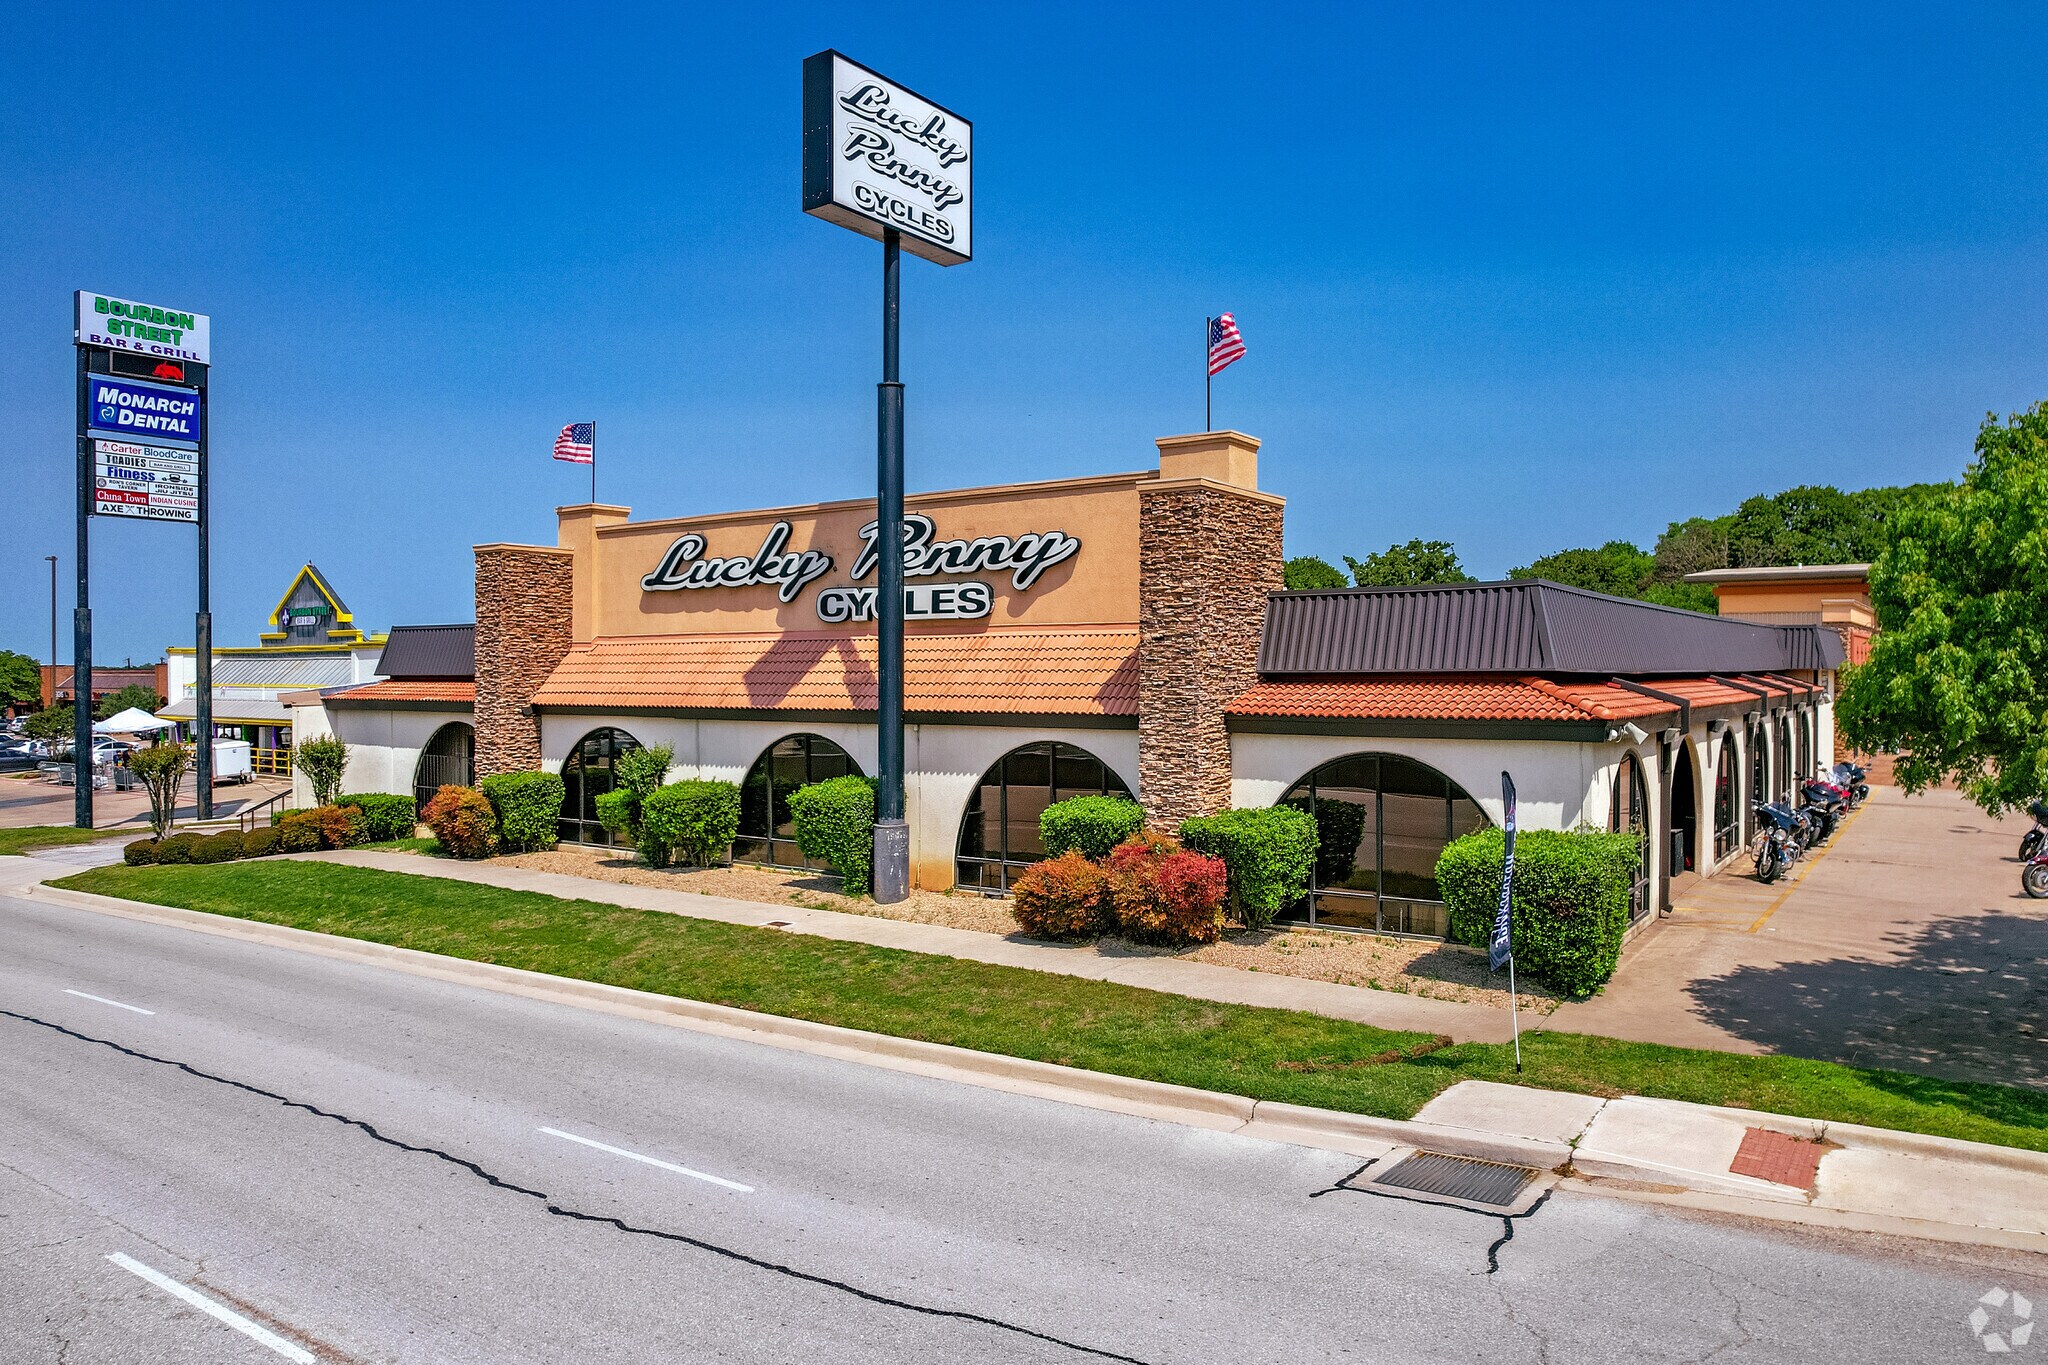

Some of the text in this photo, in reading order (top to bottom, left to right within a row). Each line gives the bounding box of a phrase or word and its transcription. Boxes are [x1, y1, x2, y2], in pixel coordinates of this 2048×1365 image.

[837, 80, 968, 169] Lucky
[841, 122, 964, 211] Penny
[851, 180, 955, 244] CYCLES
[95, 296, 195, 331] BOURBON
[107, 317, 184, 346] STREET
[90, 333, 201, 361] BAR & GRILL
[97, 386, 195, 416] MONARCH
[117, 408, 190, 434] DENTAL
[110, 443, 193, 461] Carter BloodCare
[107, 466, 156, 481] Fitness
[155, 483, 194, 492] IRONSIDE
[97, 490, 147, 504] China Town
[150, 496, 197, 507] INDIAN CUSINE
[101, 504, 192, 519] AXE THROWING
[641, 519, 833, 603] Lucky
[816, 582, 994, 623] CYLES
